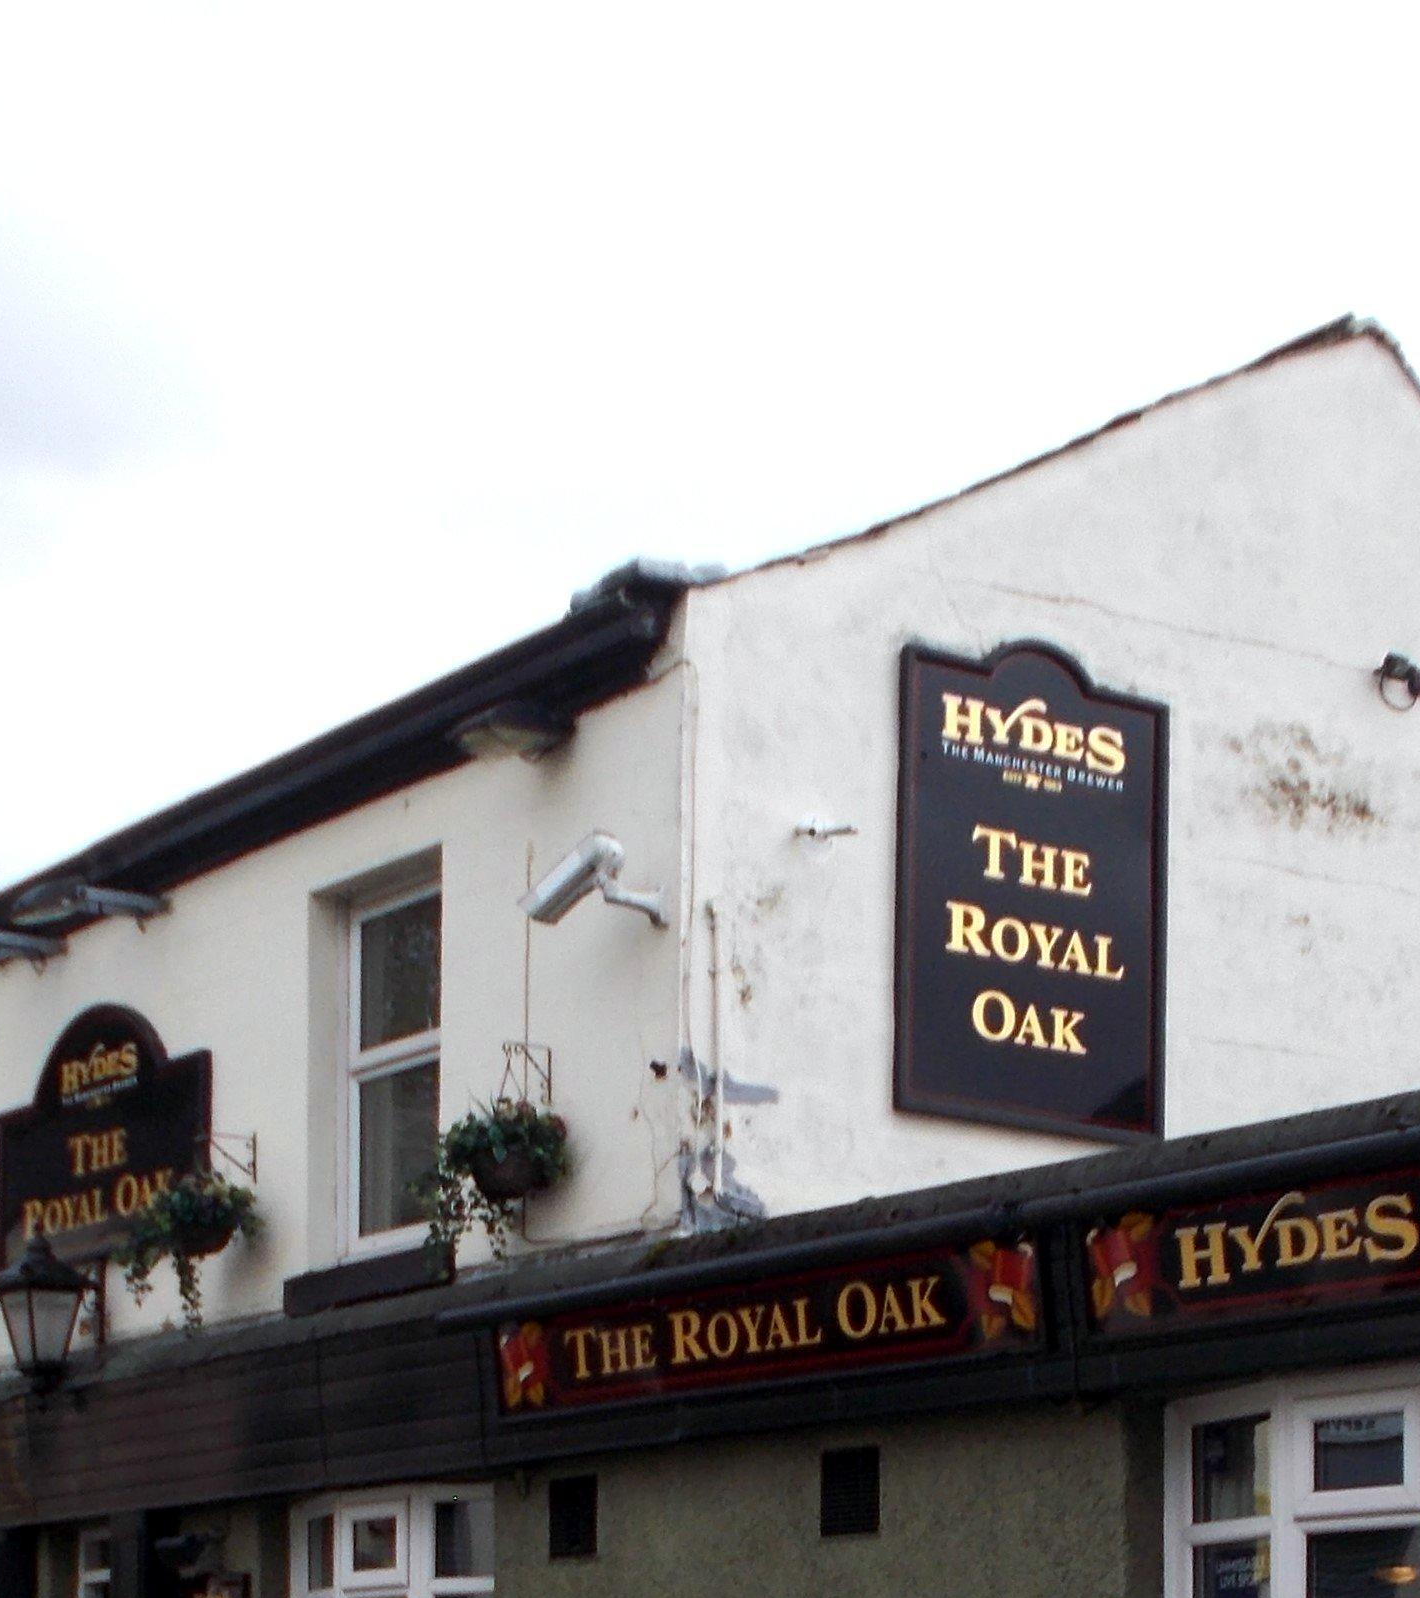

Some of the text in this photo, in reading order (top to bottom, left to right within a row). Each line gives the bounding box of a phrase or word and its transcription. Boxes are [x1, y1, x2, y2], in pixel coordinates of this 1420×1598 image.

[941, 692, 1127, 774] HYDES
[941, 740, 970, 762] THE
[973, 746, 1062, 778] MANCHESTER
[1066, 766, 1125, 793] BREWER
[971, 824, 1092, 897] THE
[945, 900, 1125, 981] ROYAL
[971, 989, 1088, 1055] OAK
[67, 1126, 128, 1177] THE
[1174, 1191, 1420, 1290] HYDES
[564, 1275, 947, 1380] THE ROYAL OAK
